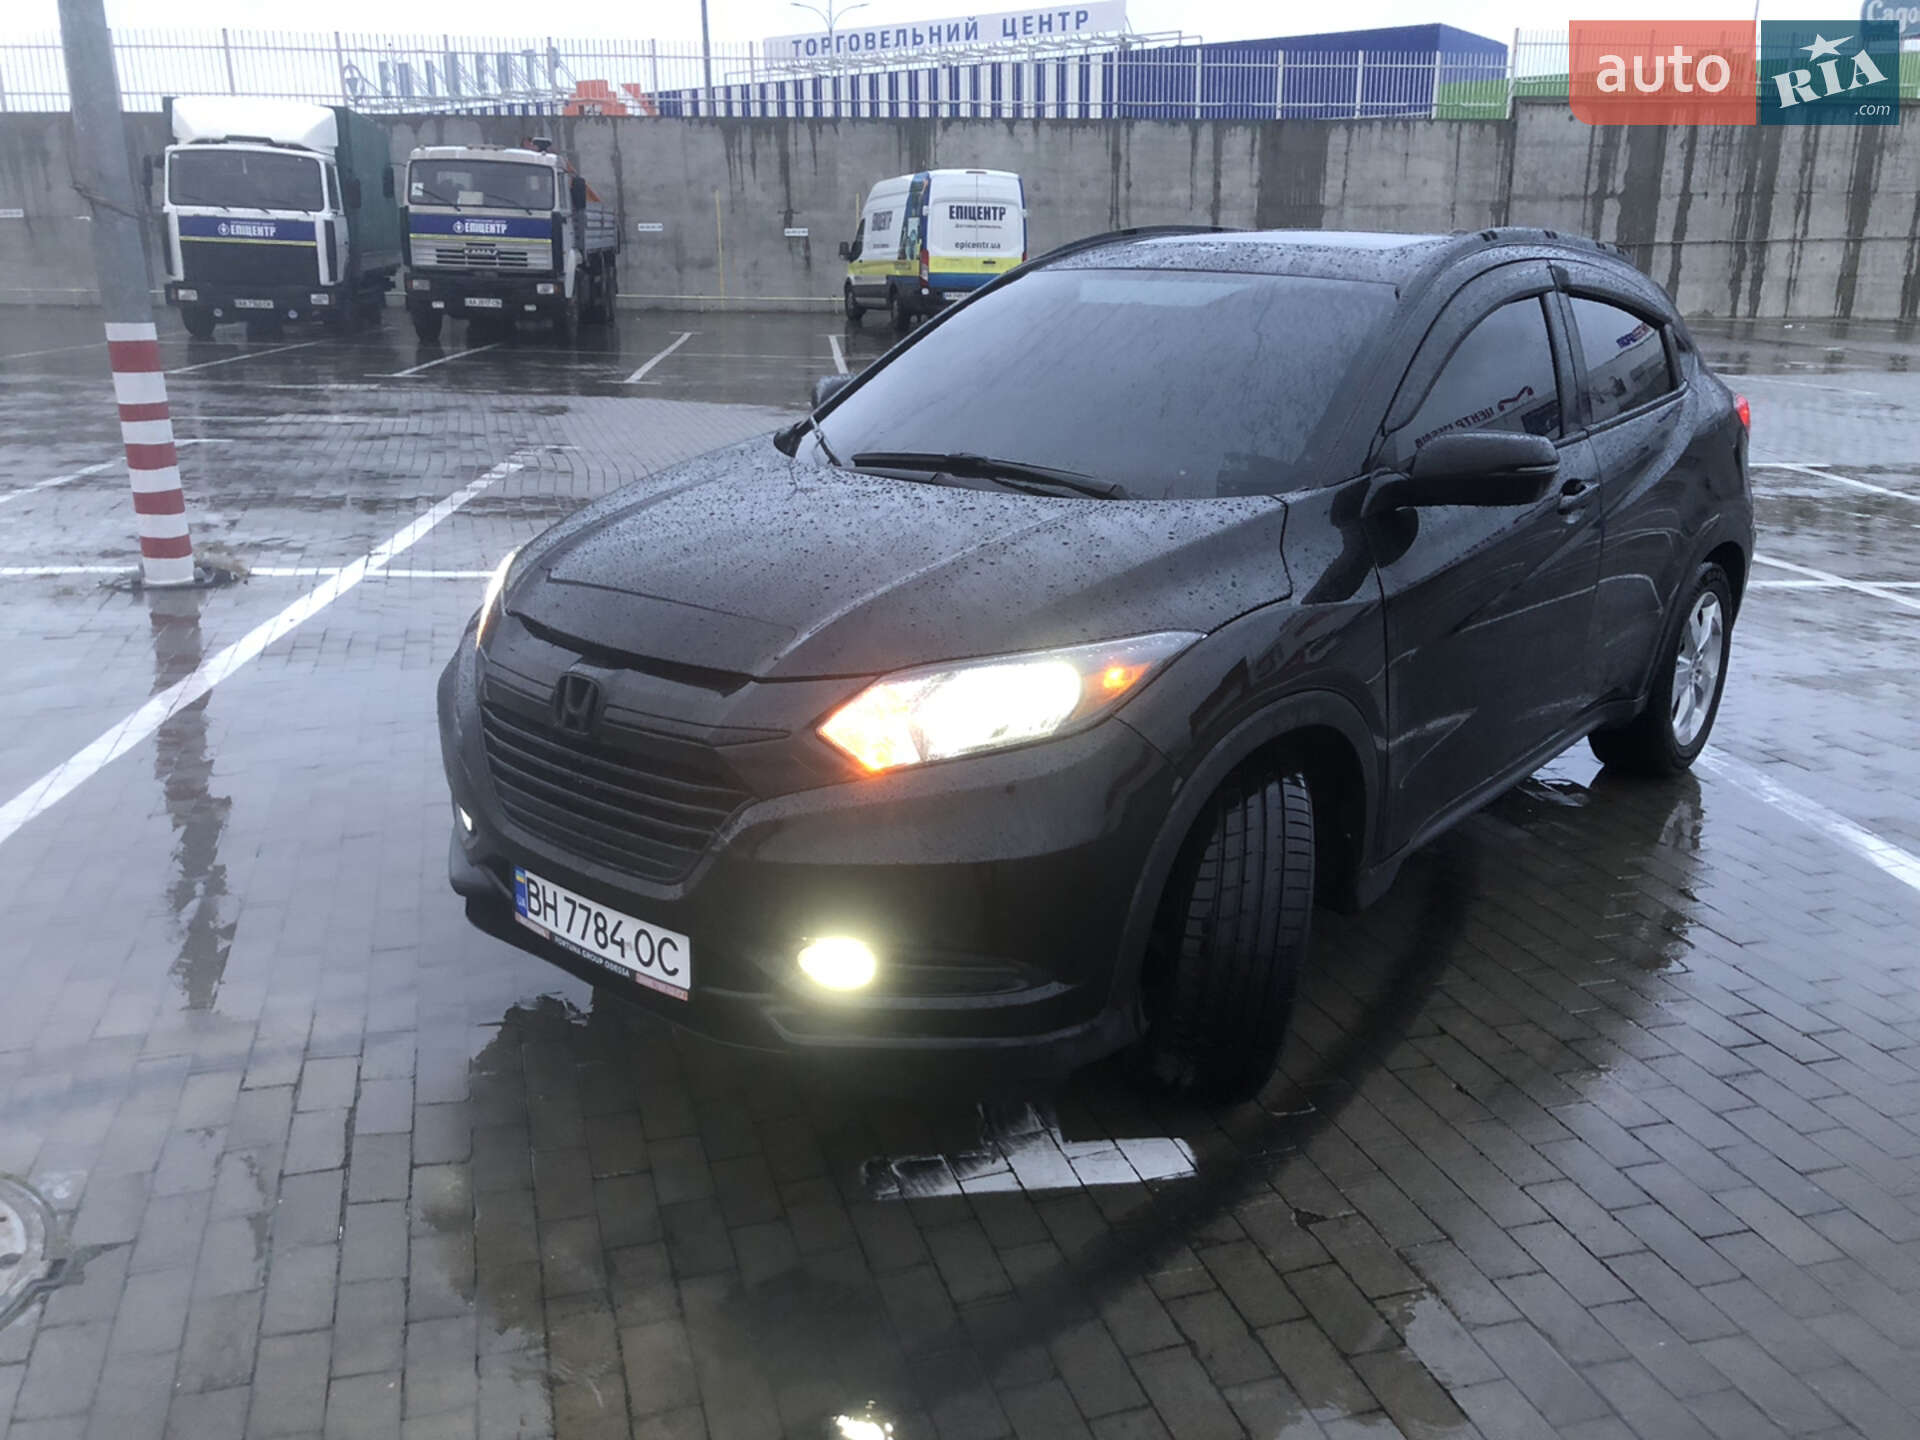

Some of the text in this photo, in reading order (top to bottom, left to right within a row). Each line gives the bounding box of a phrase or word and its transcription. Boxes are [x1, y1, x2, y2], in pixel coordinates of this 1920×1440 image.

[792, 10, 1090, 57] ТОРГОВЕЛЬНИЙ ЦЕНТР
[949, 205, 1006, 220] ЕПІЦЕНТР
[955, 240, 1001, 249] epicentr.ua
[564, 896, 626, 959] 7784
